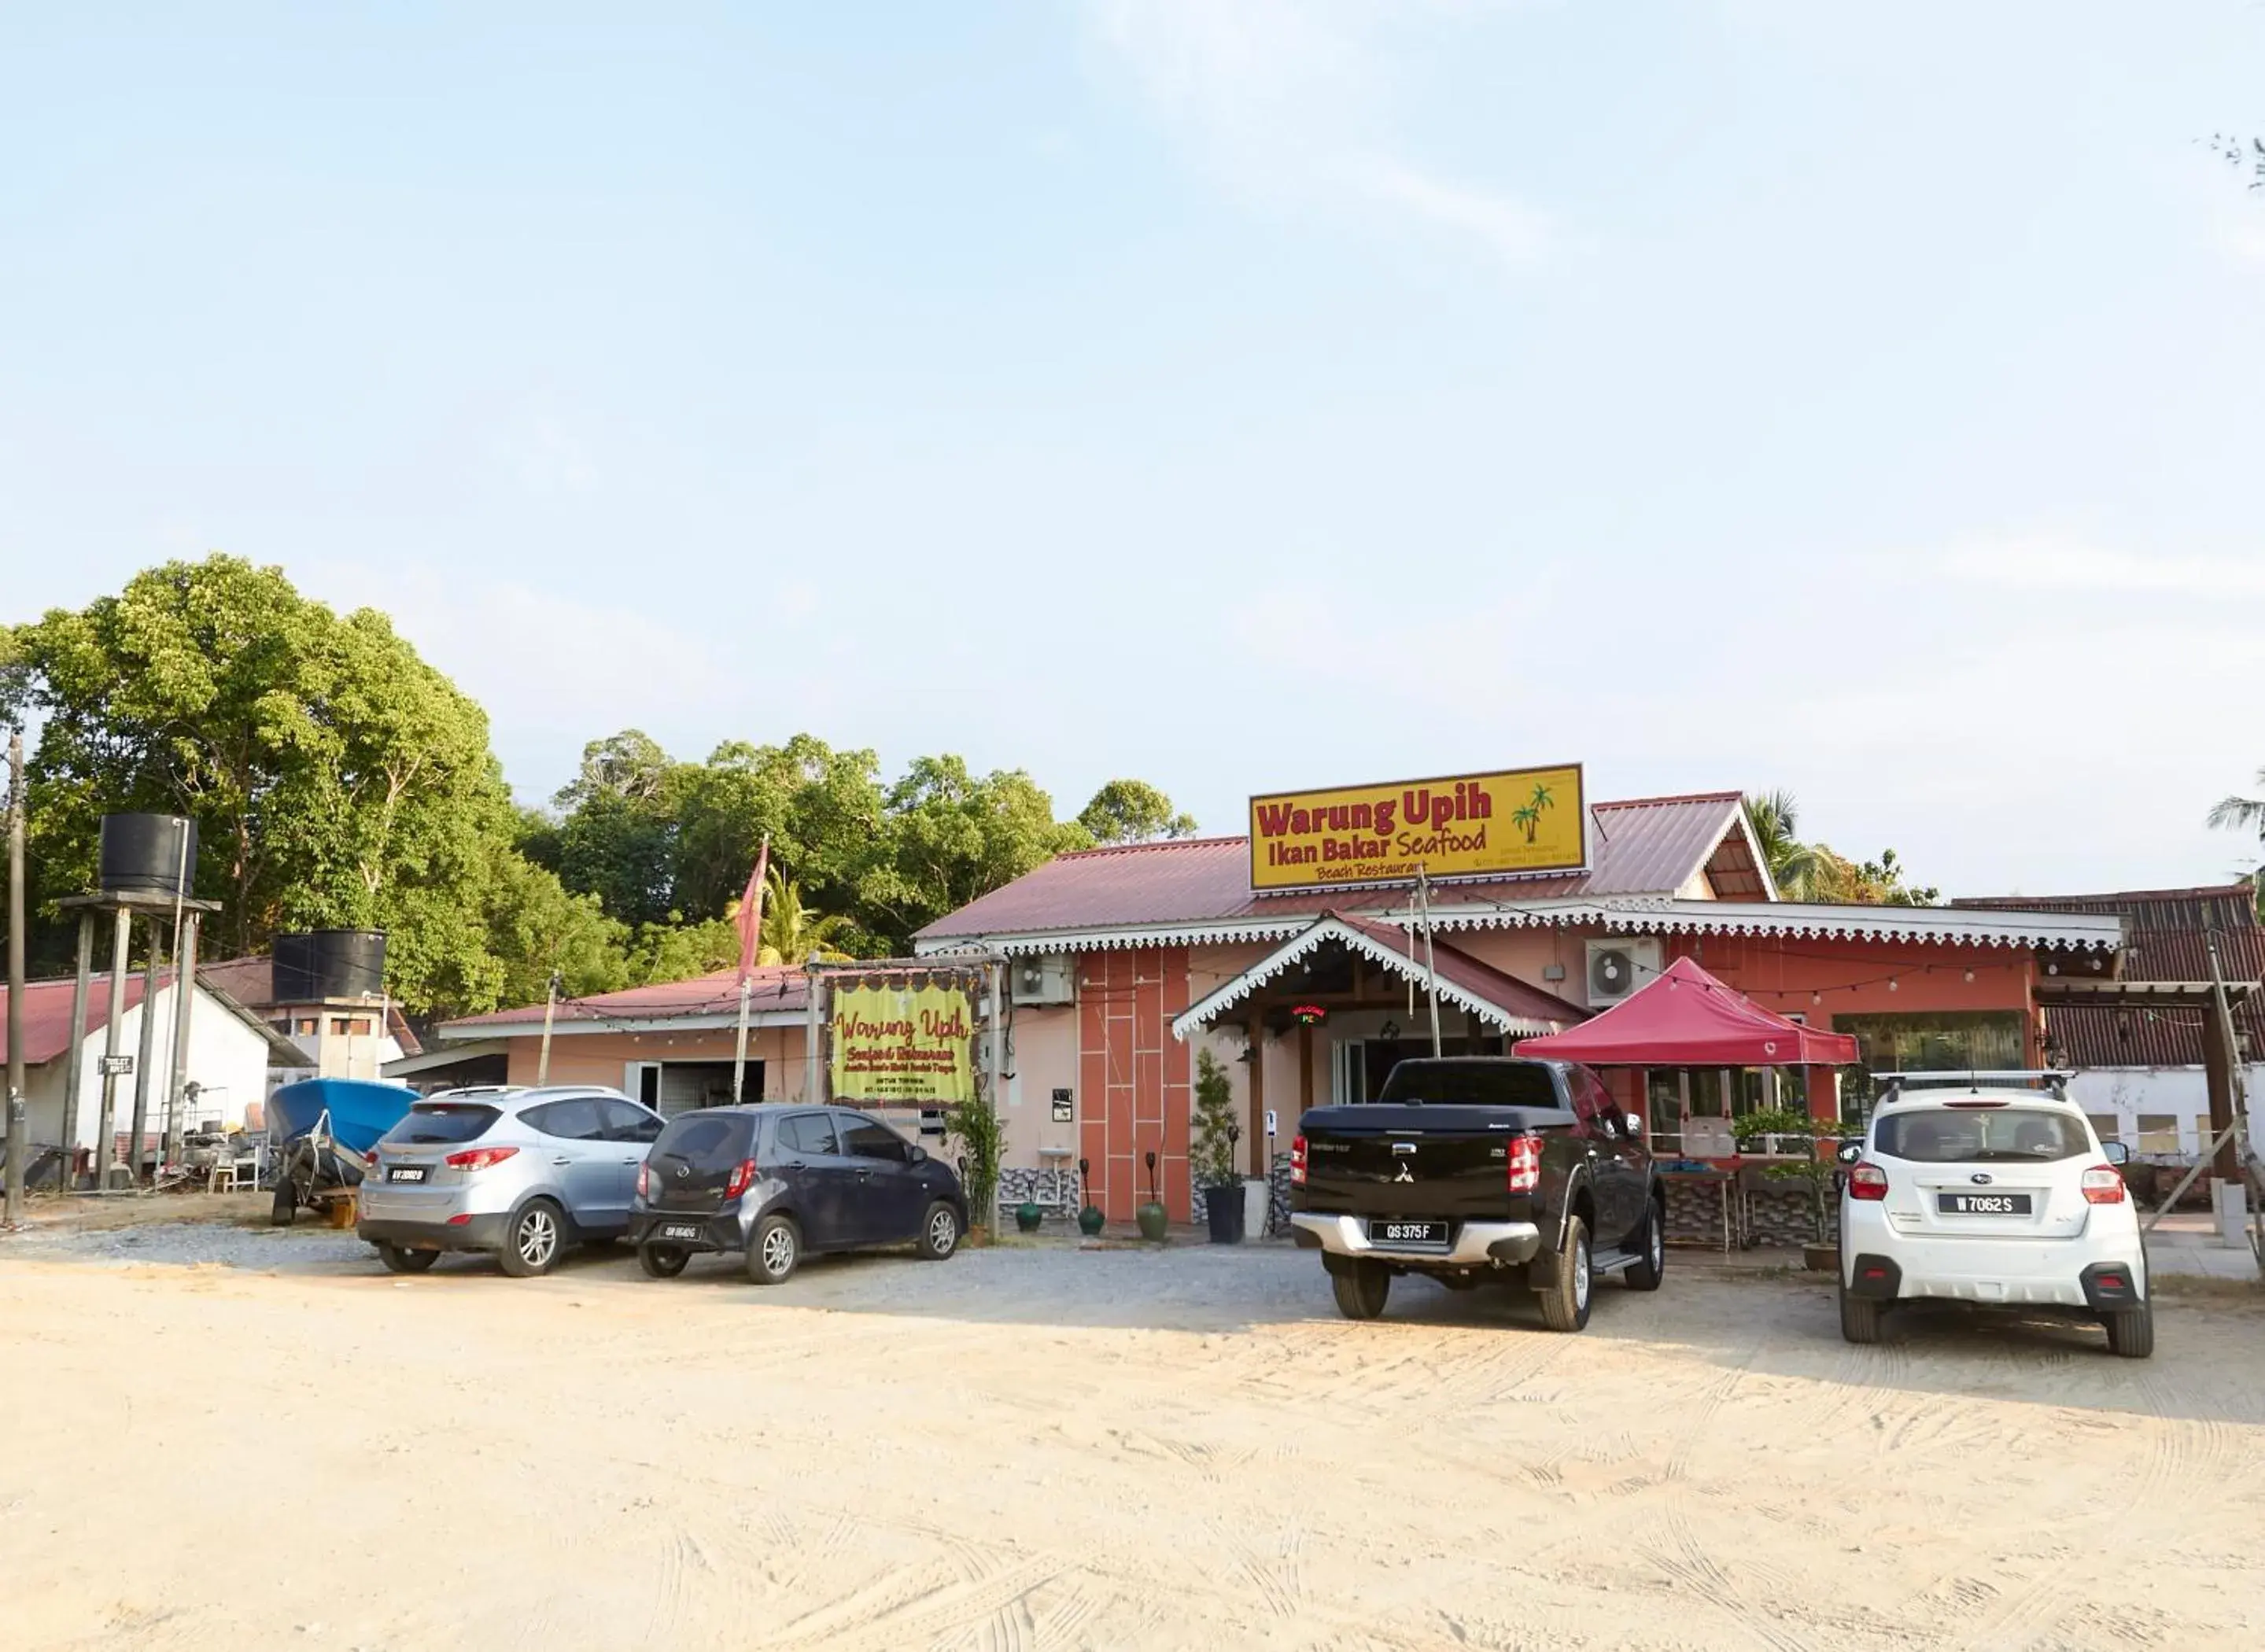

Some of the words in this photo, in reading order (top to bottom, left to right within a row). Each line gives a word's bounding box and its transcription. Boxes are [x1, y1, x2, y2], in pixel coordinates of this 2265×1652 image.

[1256, 798, 1396, 836] Warung
[1404, 782, 1492, 832] Upih
[1268, 841, 1318, 866] Ikan
[1322, 834, 1391, 862] Bakar
[1396, 824, 1486, 857] Seafood
[1315, 865, 1353, 879] Beach
[837, 1012, 916, 1046] Warung
[1957, 1197, 1967, 1211] W
[1968, 1197, 2002, 1211] 7062
[2003, 1197, 2012, 1211] S
[1387, 1225, 1401, 1238] QS
[1402, 1225, 1422, 1238] 375
[1422, 1225, 1430, 1239] F
